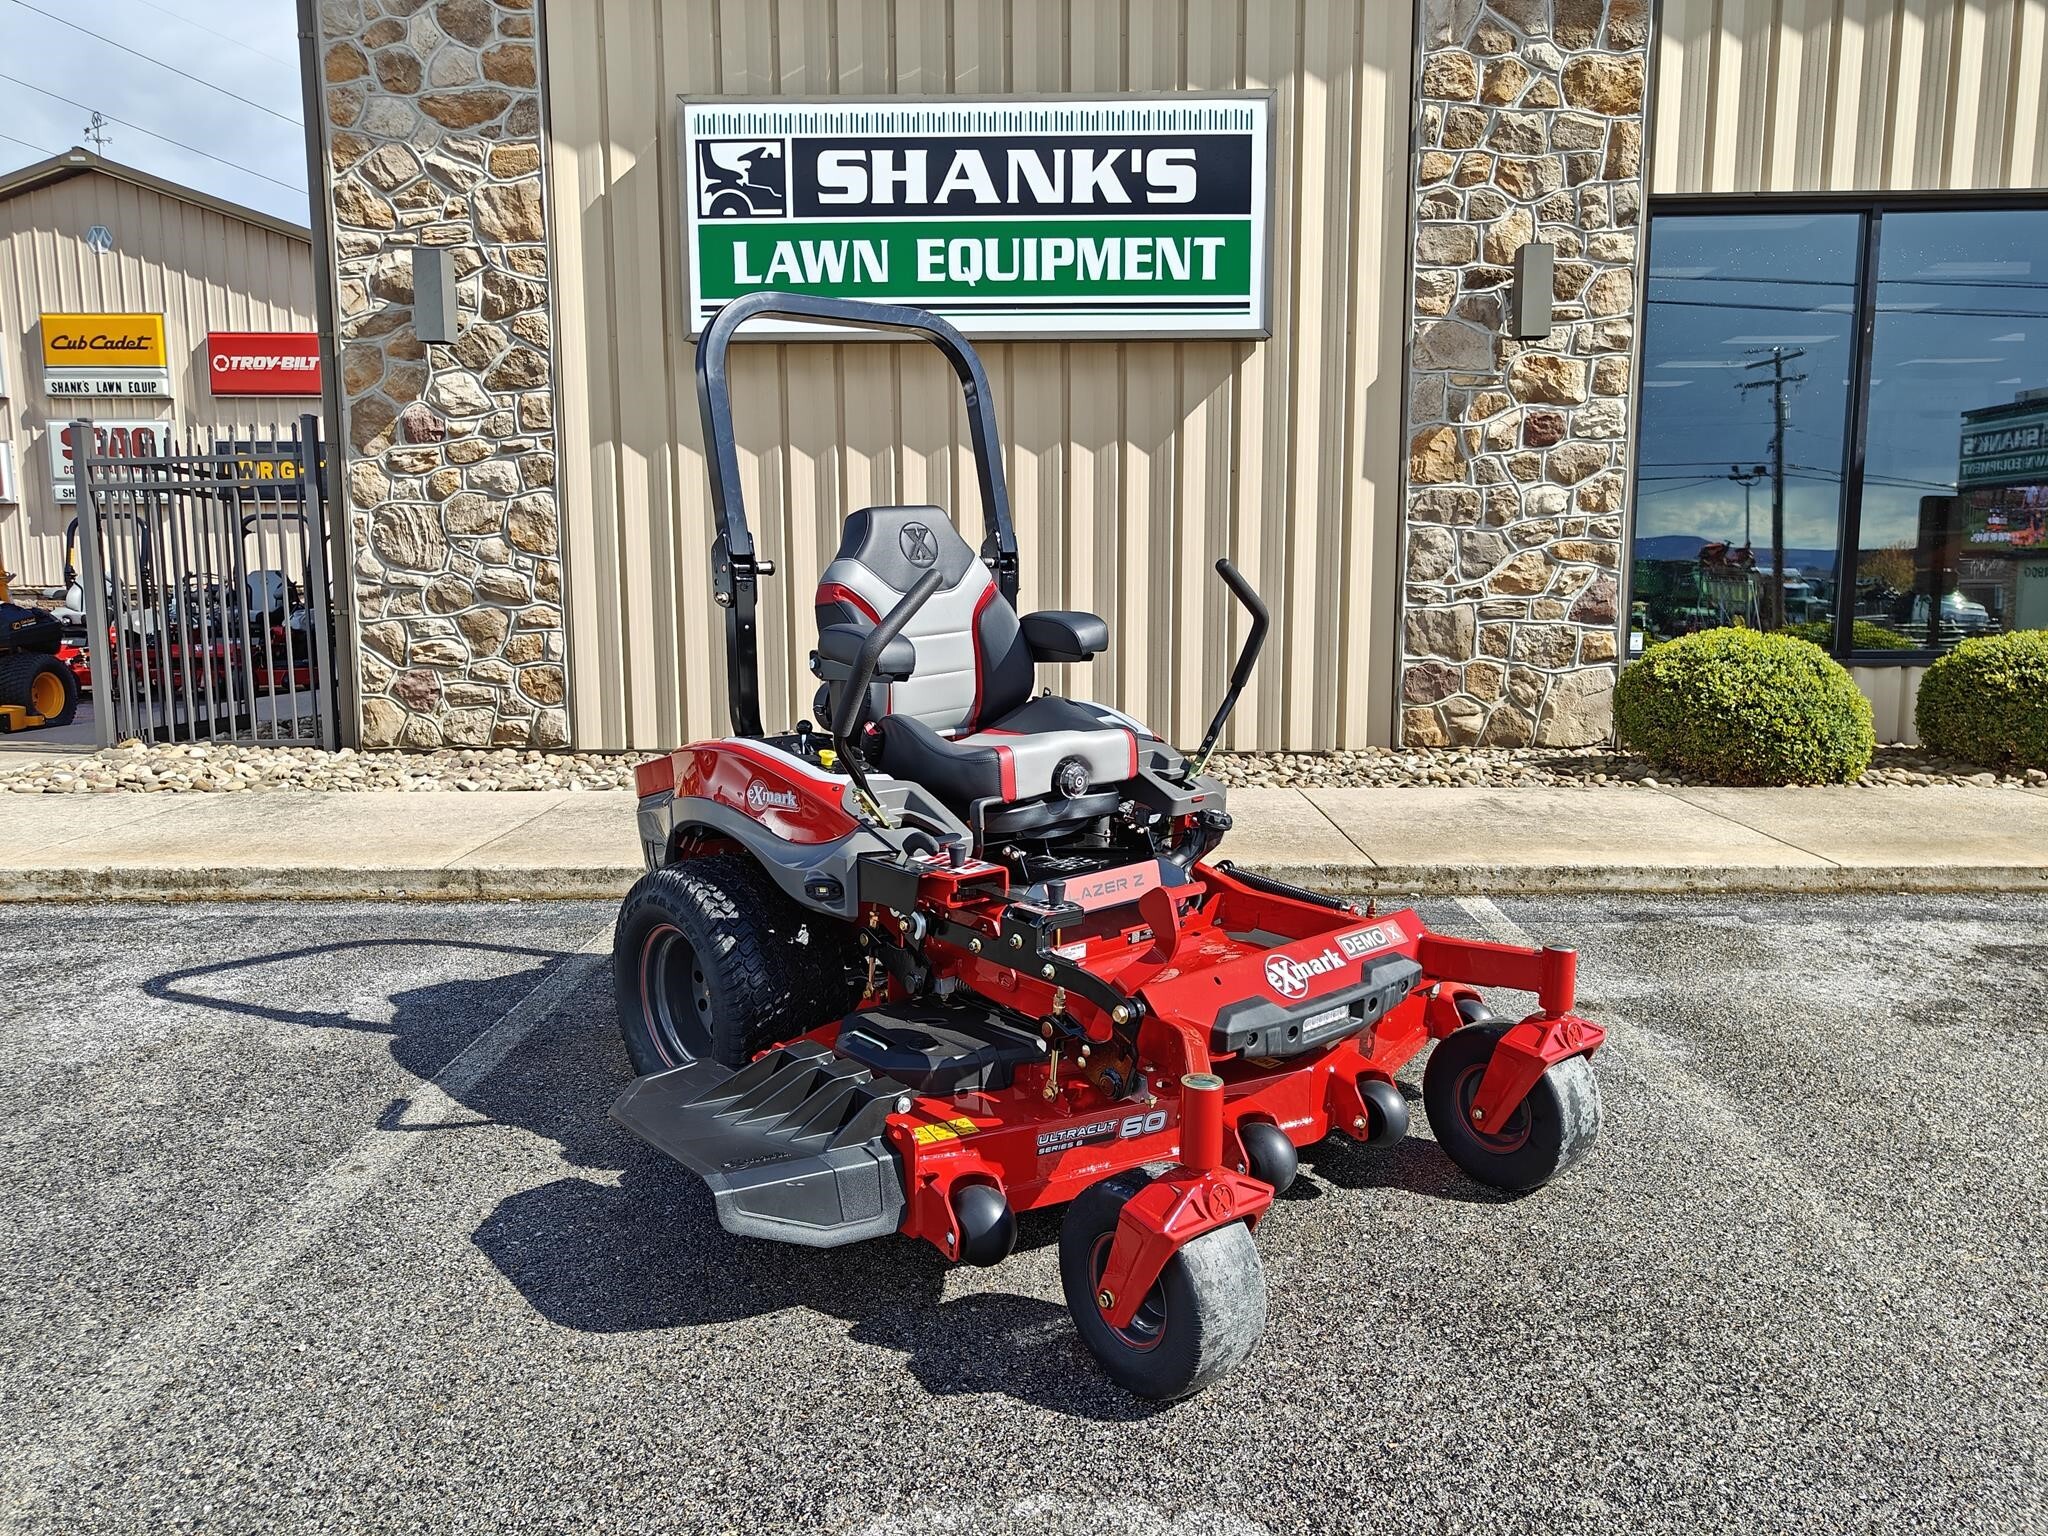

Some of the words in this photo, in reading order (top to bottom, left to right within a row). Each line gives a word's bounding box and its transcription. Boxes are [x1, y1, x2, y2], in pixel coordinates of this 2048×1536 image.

[816, 148, 1198, 205] SHANK'S
[732, 239, 890, 284] LAWN
[916, 236, 1226, 287] EQUIPMENT
[51, 334, 88, 350] Cub
[89, 334, 152, 350] Cadet
[229, 355, 321, 371] TROY-BILT
[51, 380, 90, 393] SHANK'S
[96, 381, 122, 393] LAWN
[1133, 873, 1145, 887] Z
[1341, 928, 1388, 956] DEMO
[1266, 948, 1348, 995] eXmark
[1038, 1119, 1119, 1146] ULTRACUT
[1119, 1110, 1168, 1139] 60
[1038, 1142, 1074, 1155] SERIES
